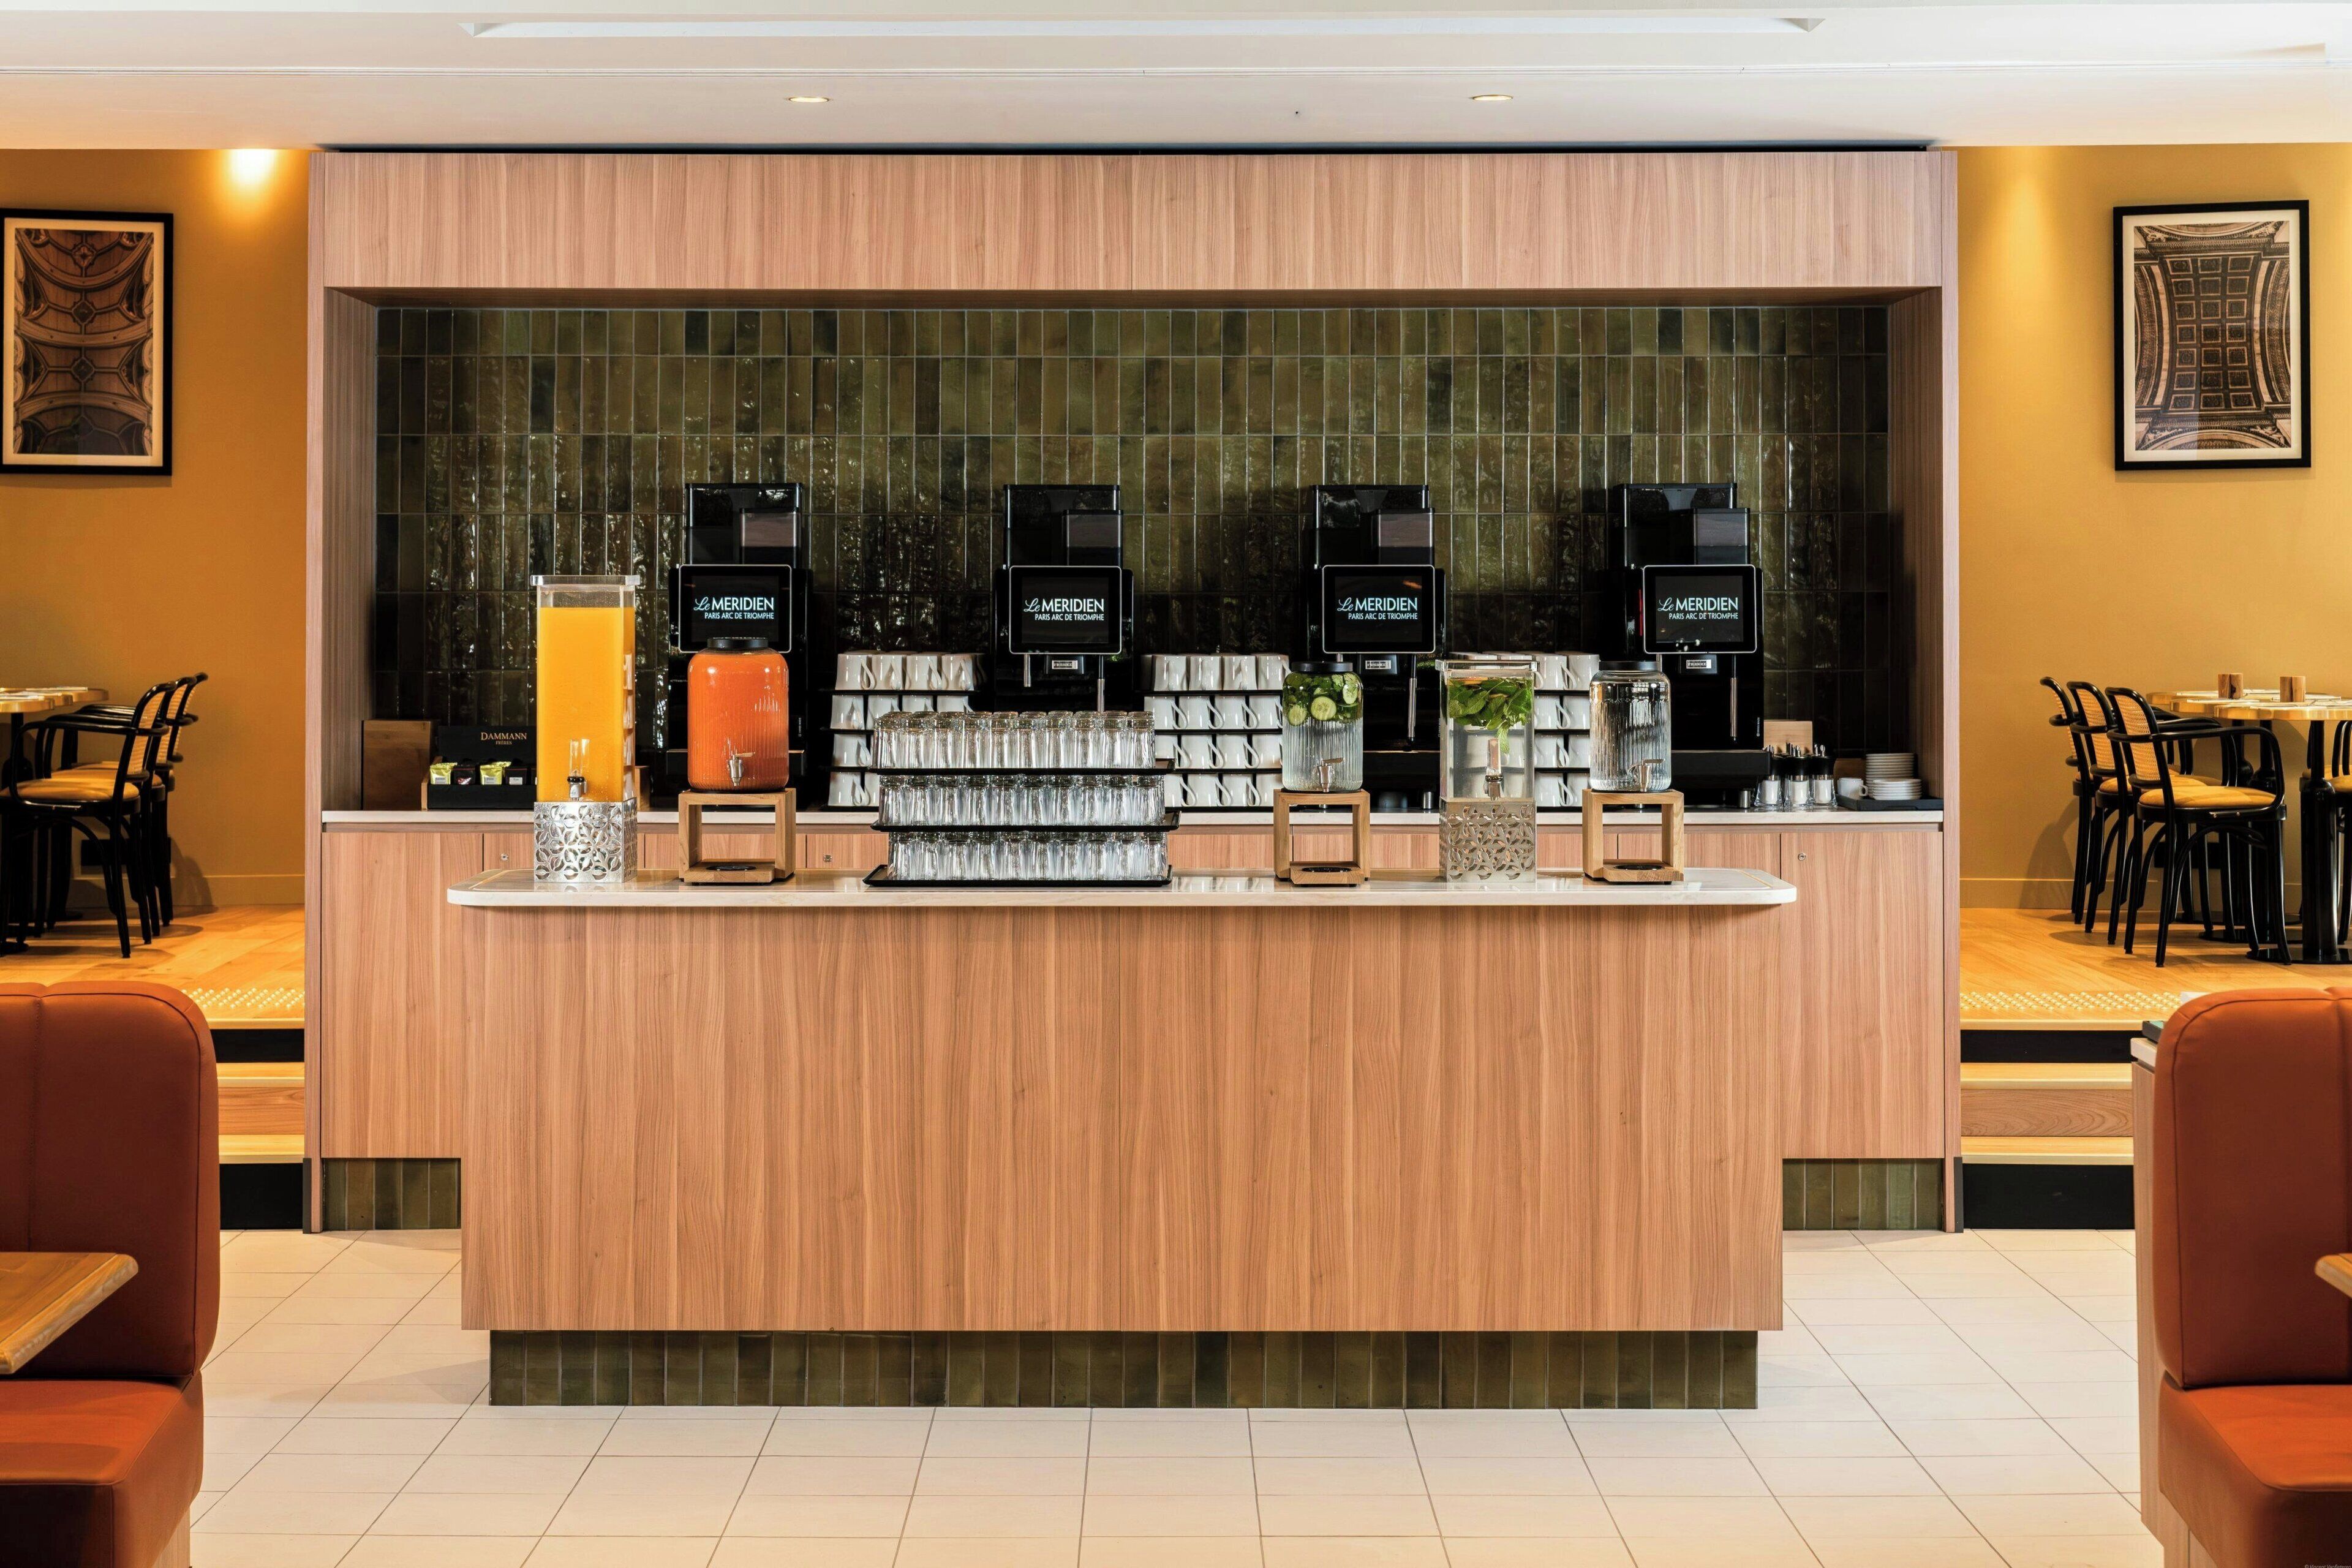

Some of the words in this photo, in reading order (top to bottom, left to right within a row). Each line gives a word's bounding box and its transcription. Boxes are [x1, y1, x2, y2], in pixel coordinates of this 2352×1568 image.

[694, 597, 710, 611] Le
[712, 597, 774, 611] MERIDIEN
[1023, 598, 1041, 612] Le
[1041, 598, 1104, 612] MERIDIEN
[1336, 597, 1354, 611] Le
[1355, 597, 1418, 611] MERIDIEN
[1657, 597, 1674, 611] Le
[1675, 597, 1738, 611] MERIDIEN
[481, 732, 527, 741] DAMMANN
